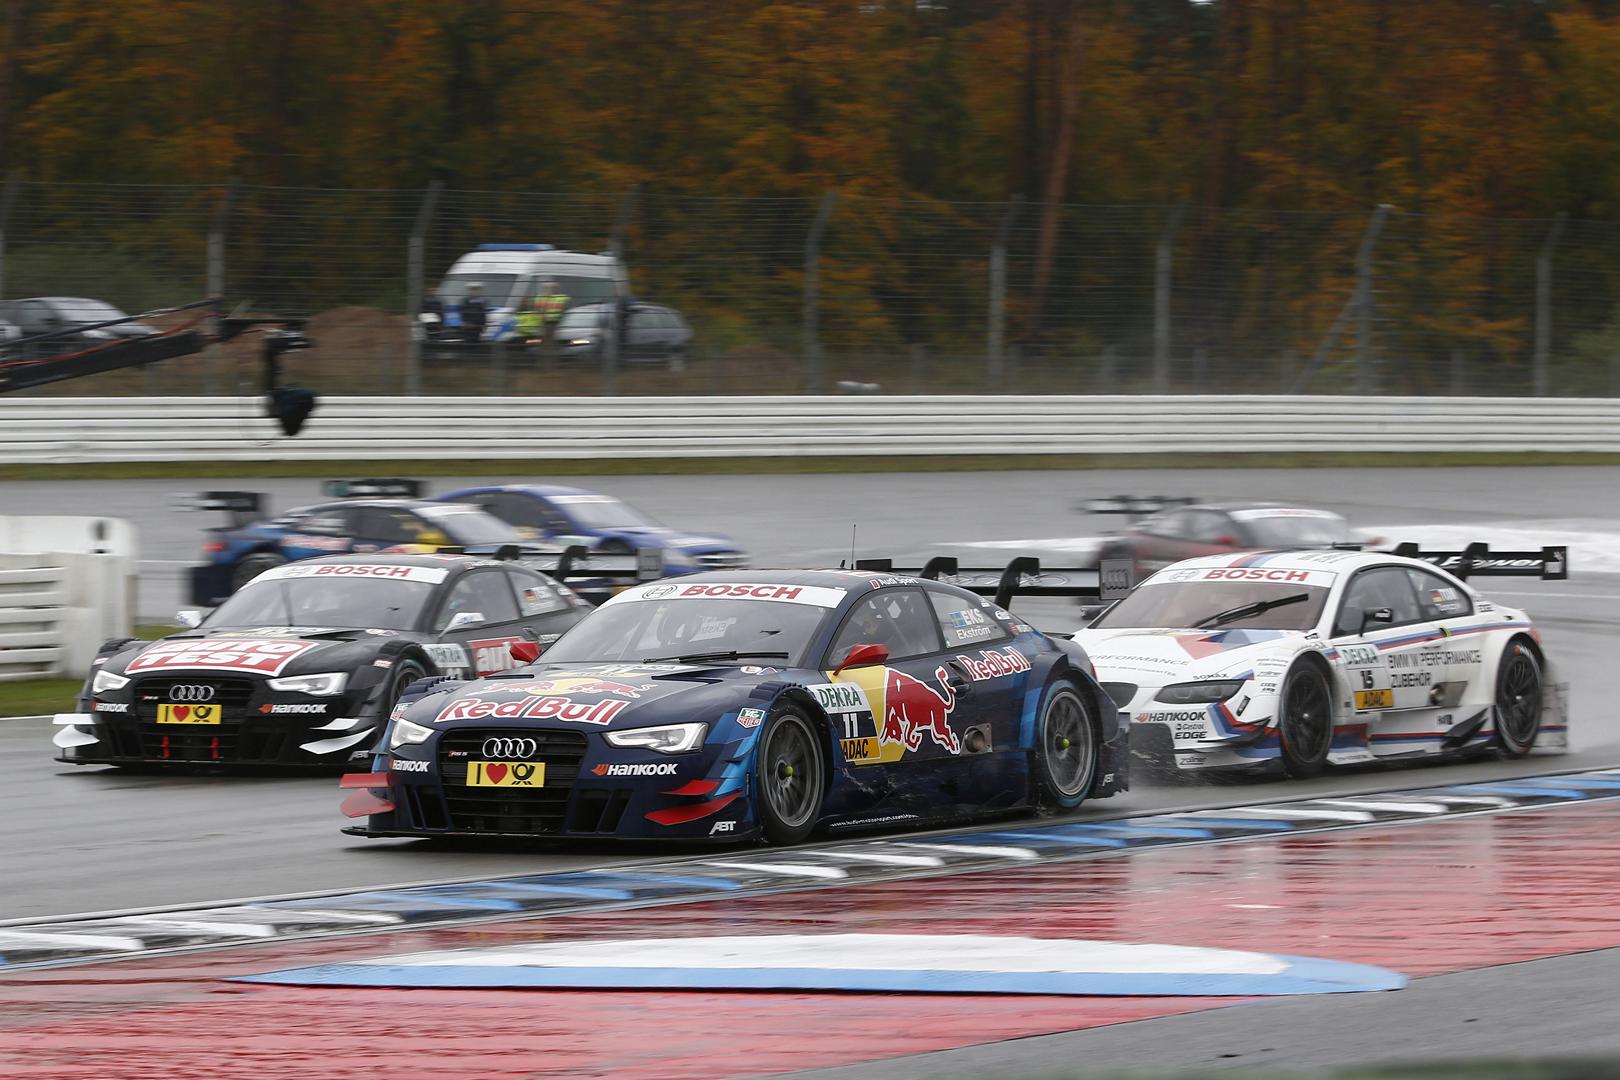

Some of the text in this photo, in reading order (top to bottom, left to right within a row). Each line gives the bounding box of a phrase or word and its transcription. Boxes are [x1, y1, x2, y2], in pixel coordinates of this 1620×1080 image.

[314, 565, 411, 577] BOSCH
[1203, 569, 1310, 582] BOSCH
[680, 585, 803, 600] BOSCH
[963, 608, 985, 625] EKS
[957, 624, 991, 640] Ekström
[138, 651, 285, 666] TEST
[957, 646, 1032, 681] Red Bull
[817, 685, 863, 708] DEKRA
[436, 696, 534, 721] Red
[526, 697, 629, 724] Bull
[842, 713, 860, 738] 11
[1174, 731, 1208, 739] EDGE
[842, 739, 869, 760] ADAC
[708, 820, 737, 835] ABT
